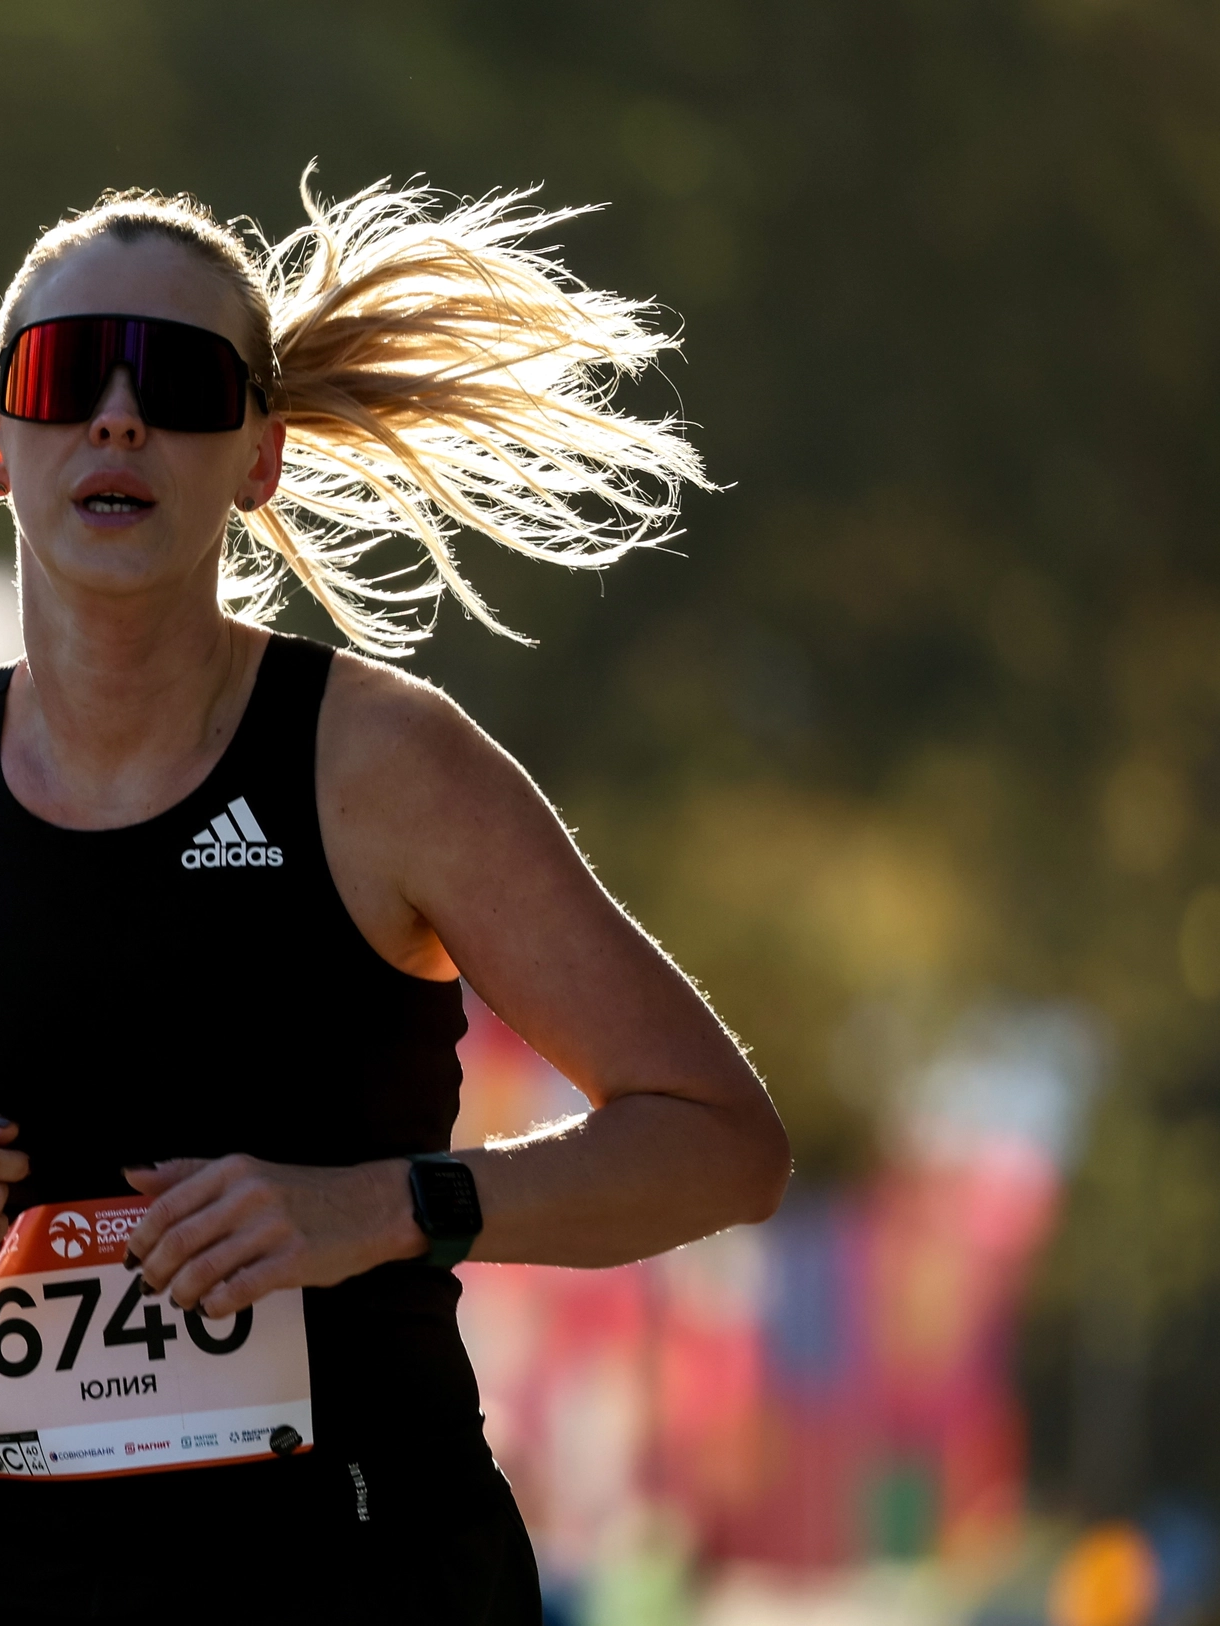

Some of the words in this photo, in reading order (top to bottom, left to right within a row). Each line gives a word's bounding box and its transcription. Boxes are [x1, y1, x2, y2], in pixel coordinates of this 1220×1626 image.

[181, 841, 284, 870] adidas
[95, 1206, 150, 1219] СОВКОМБАН
[96, 1216, 144, 1236] СОЧ
[97, 1232, 130, 1245] МАРА
[80, 1374, 158, 1402] ЮЛИЯ
[26, 1445, 39, 1457] 40
[138, 1441, 171, 1452] МАГНИТ
[58, 1446, 115, 1461] СОВКОМБАНК
[32, 1461, 45, 1471] 44
